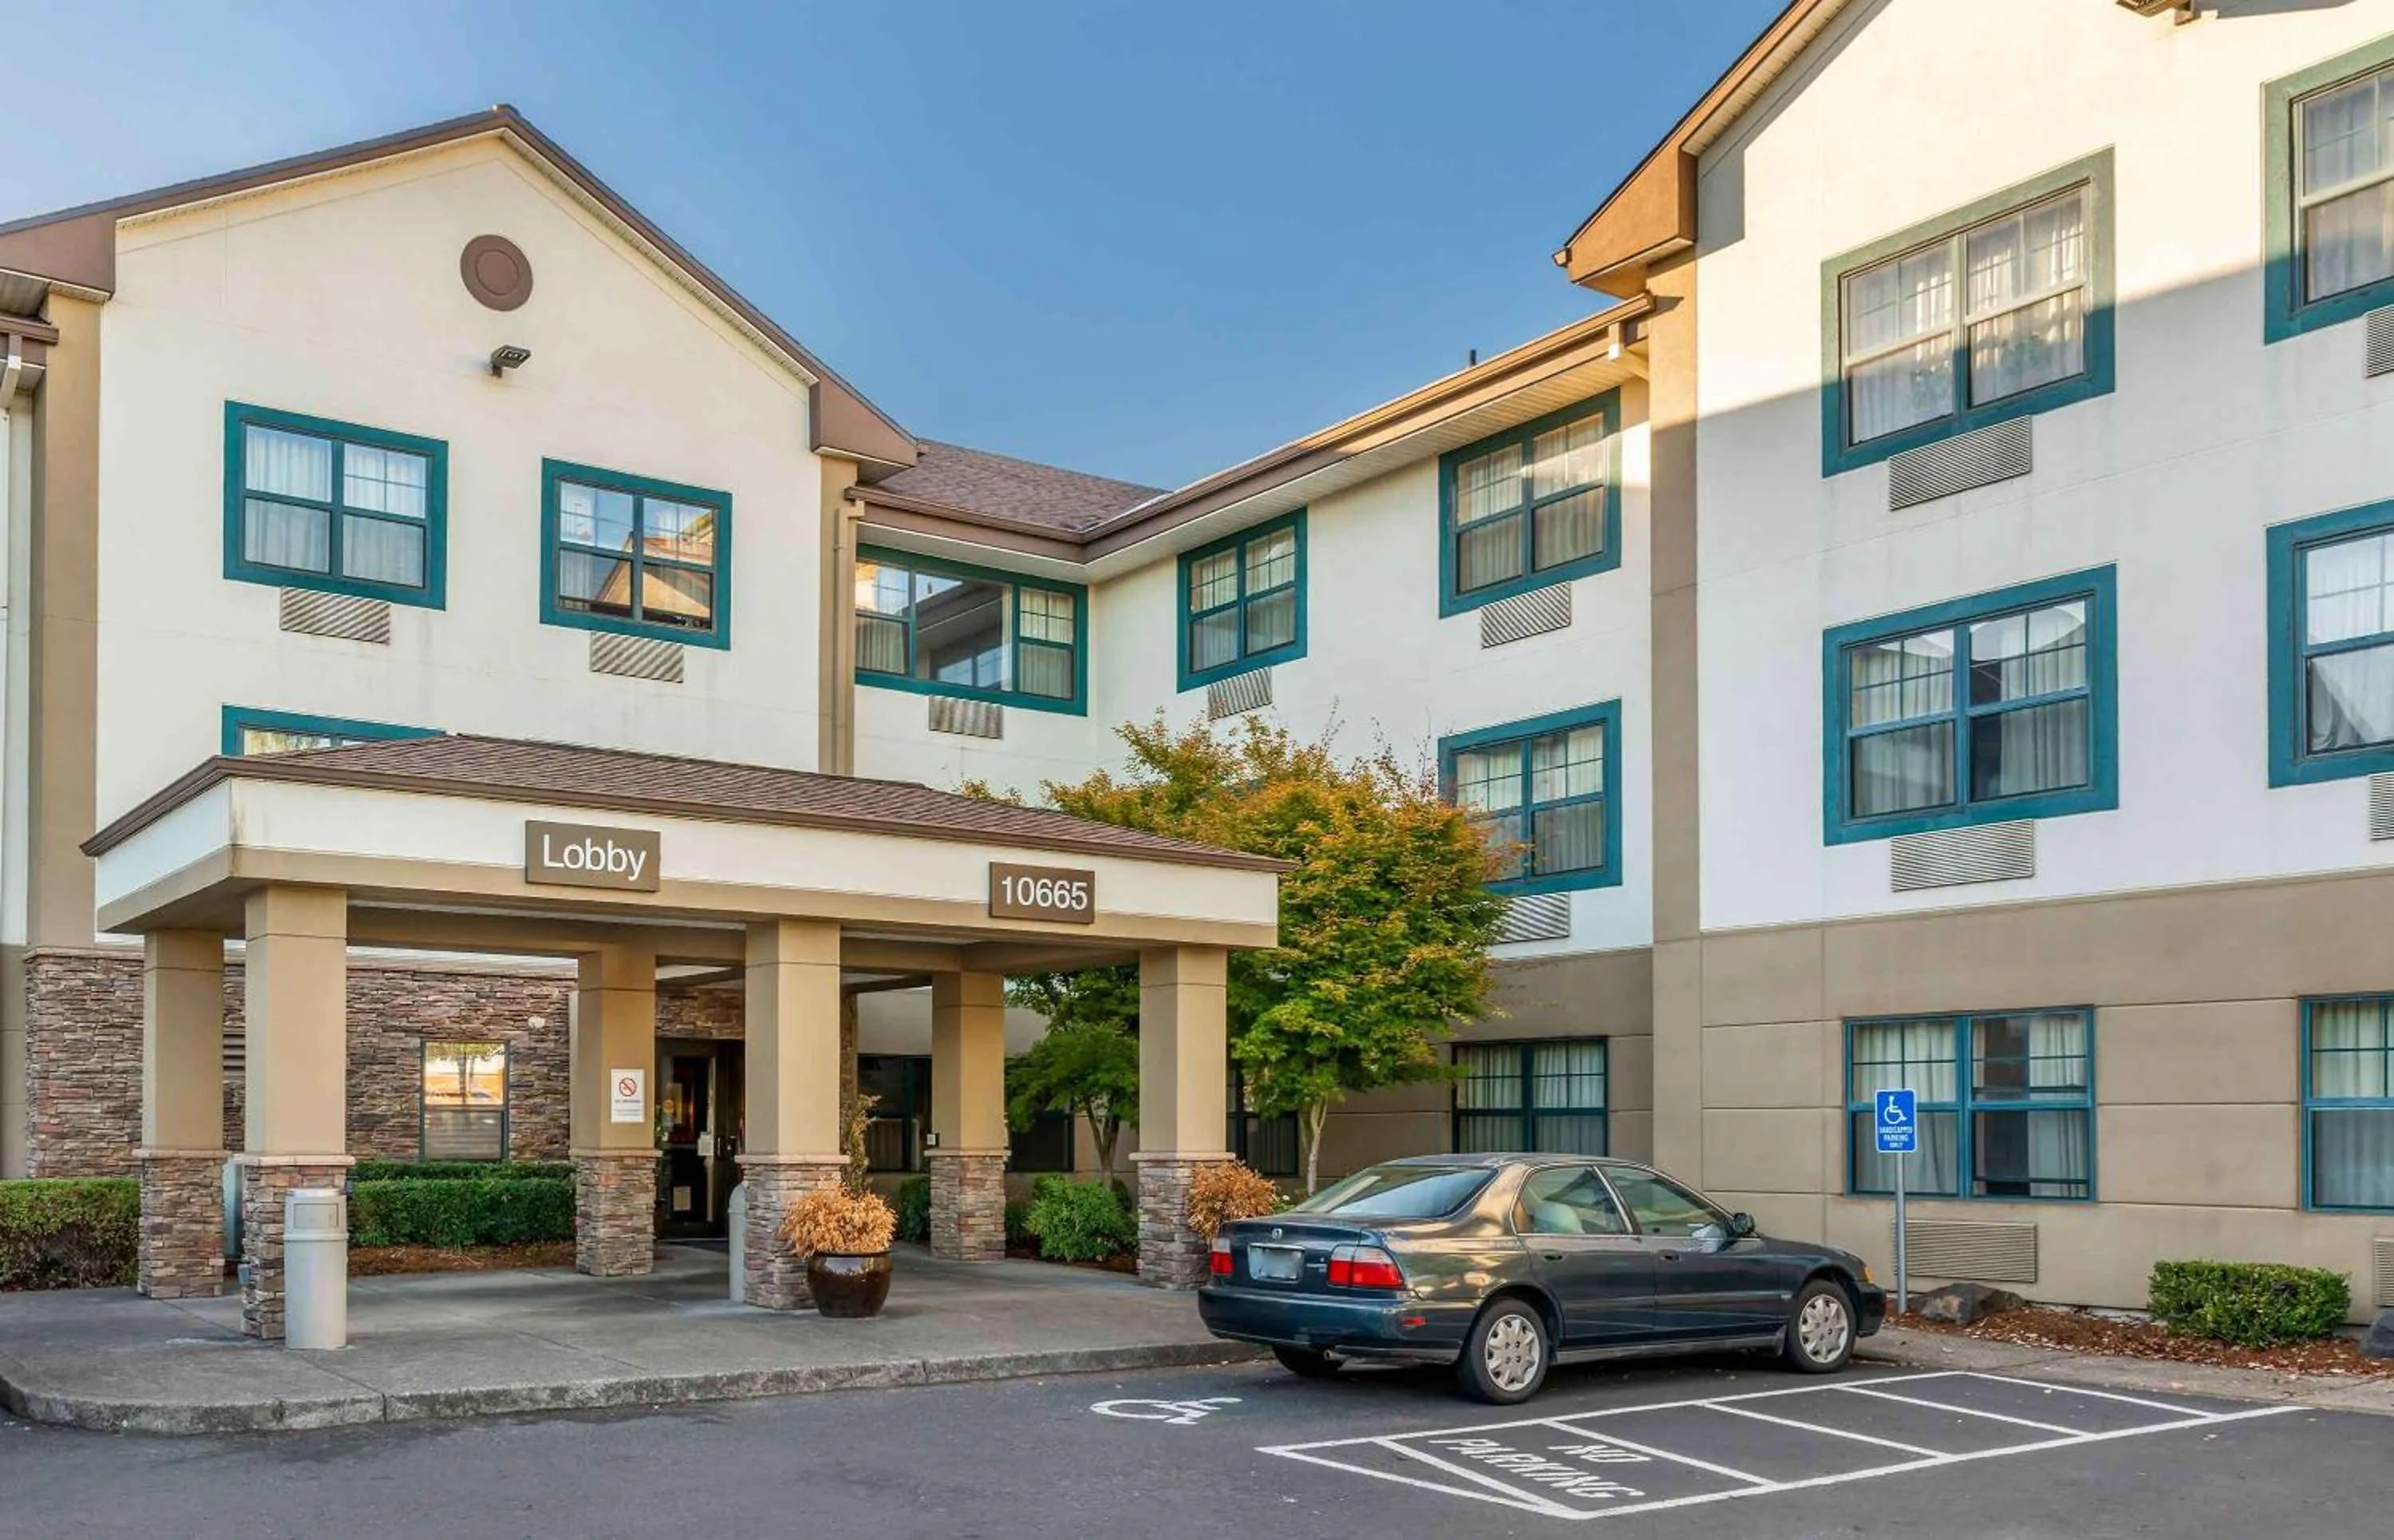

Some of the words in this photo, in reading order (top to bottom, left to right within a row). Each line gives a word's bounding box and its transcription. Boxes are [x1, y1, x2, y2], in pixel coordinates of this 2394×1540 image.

[543, 834, 647, 882] Lobby
[1001, 875, 1088, 911] 10665
[1428, 1438, 1646, 1499] PARKING
[1547, 1444, 1652, 1463] NO
